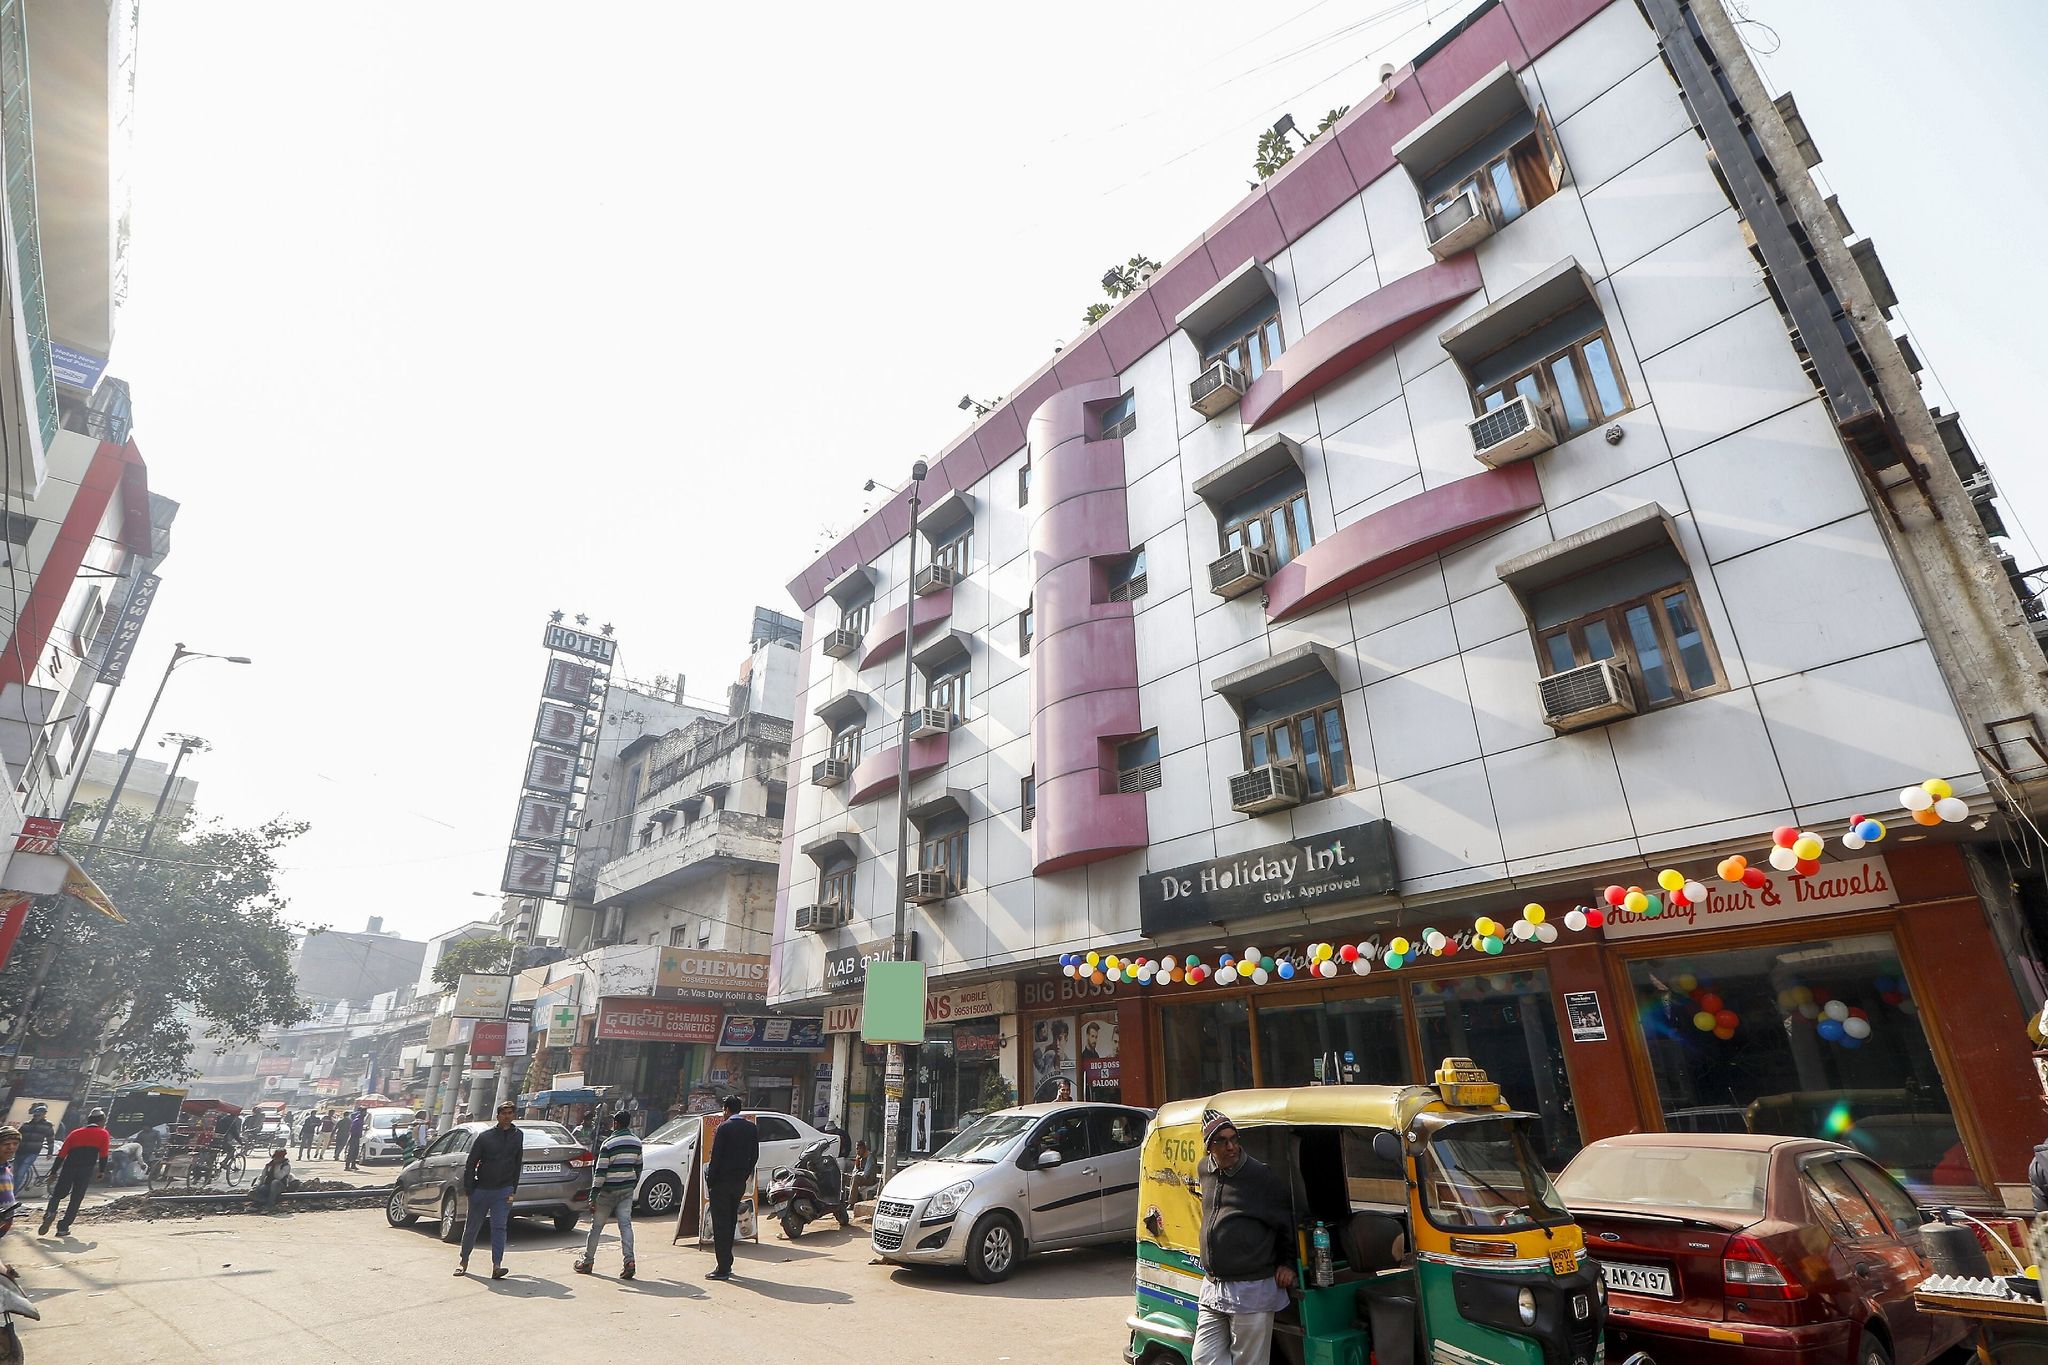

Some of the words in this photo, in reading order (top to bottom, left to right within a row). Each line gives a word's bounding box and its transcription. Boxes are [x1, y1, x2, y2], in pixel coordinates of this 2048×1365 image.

[129, 578, 155, 616] SNOW
[109, 620, 140, 671] WHITE
[551, 628, 610, 659] HOTEL
[518, 708, 577, 886] BENZ
[1161, 875, 1193, 902] De
[1200, 854, 1299, 894] Holiday
[1304, 839, 1355, 872] Int.
[1263, 891, 1295, 904] Govt.
[1299, 875, 1361, 898] Approved
[1606, 892, 1696, 925] Hoday
[1706, 887, 1756, 914] Tour
[1761, 879, 1782, 906] &
[1788, 863, 1889, 903] Travels
[827, 957, 855, 978] ЛАВ
[681, 976, 718, 985] COSMETICS
[726, 980, 754, 988] GENERAL
[1024, 982, 1055, 1004] BIG
[677, 988, 689, 997] Dr.
[691, 989, 706, 998] Vas
[708, 990, 724, 999] Dev
[725, 991, 746, 1001] Kohli
[747, 993, 753, 1001] &
[960, 991, 987, 1003] MOBILE
[666, 1012, 718, 1024] CHEMIST
[828, 1006, 859, 1032] LUV
[954, 1002, 993, 1017] 9953150200
[665, 1022, 716, 1033] COSMETICS
[1103, 1060, 1120, 1068] BOSS
[1092, 1079, 1119, 1087] SALOON
[1165, 1138, 1196, 1163] 6766
